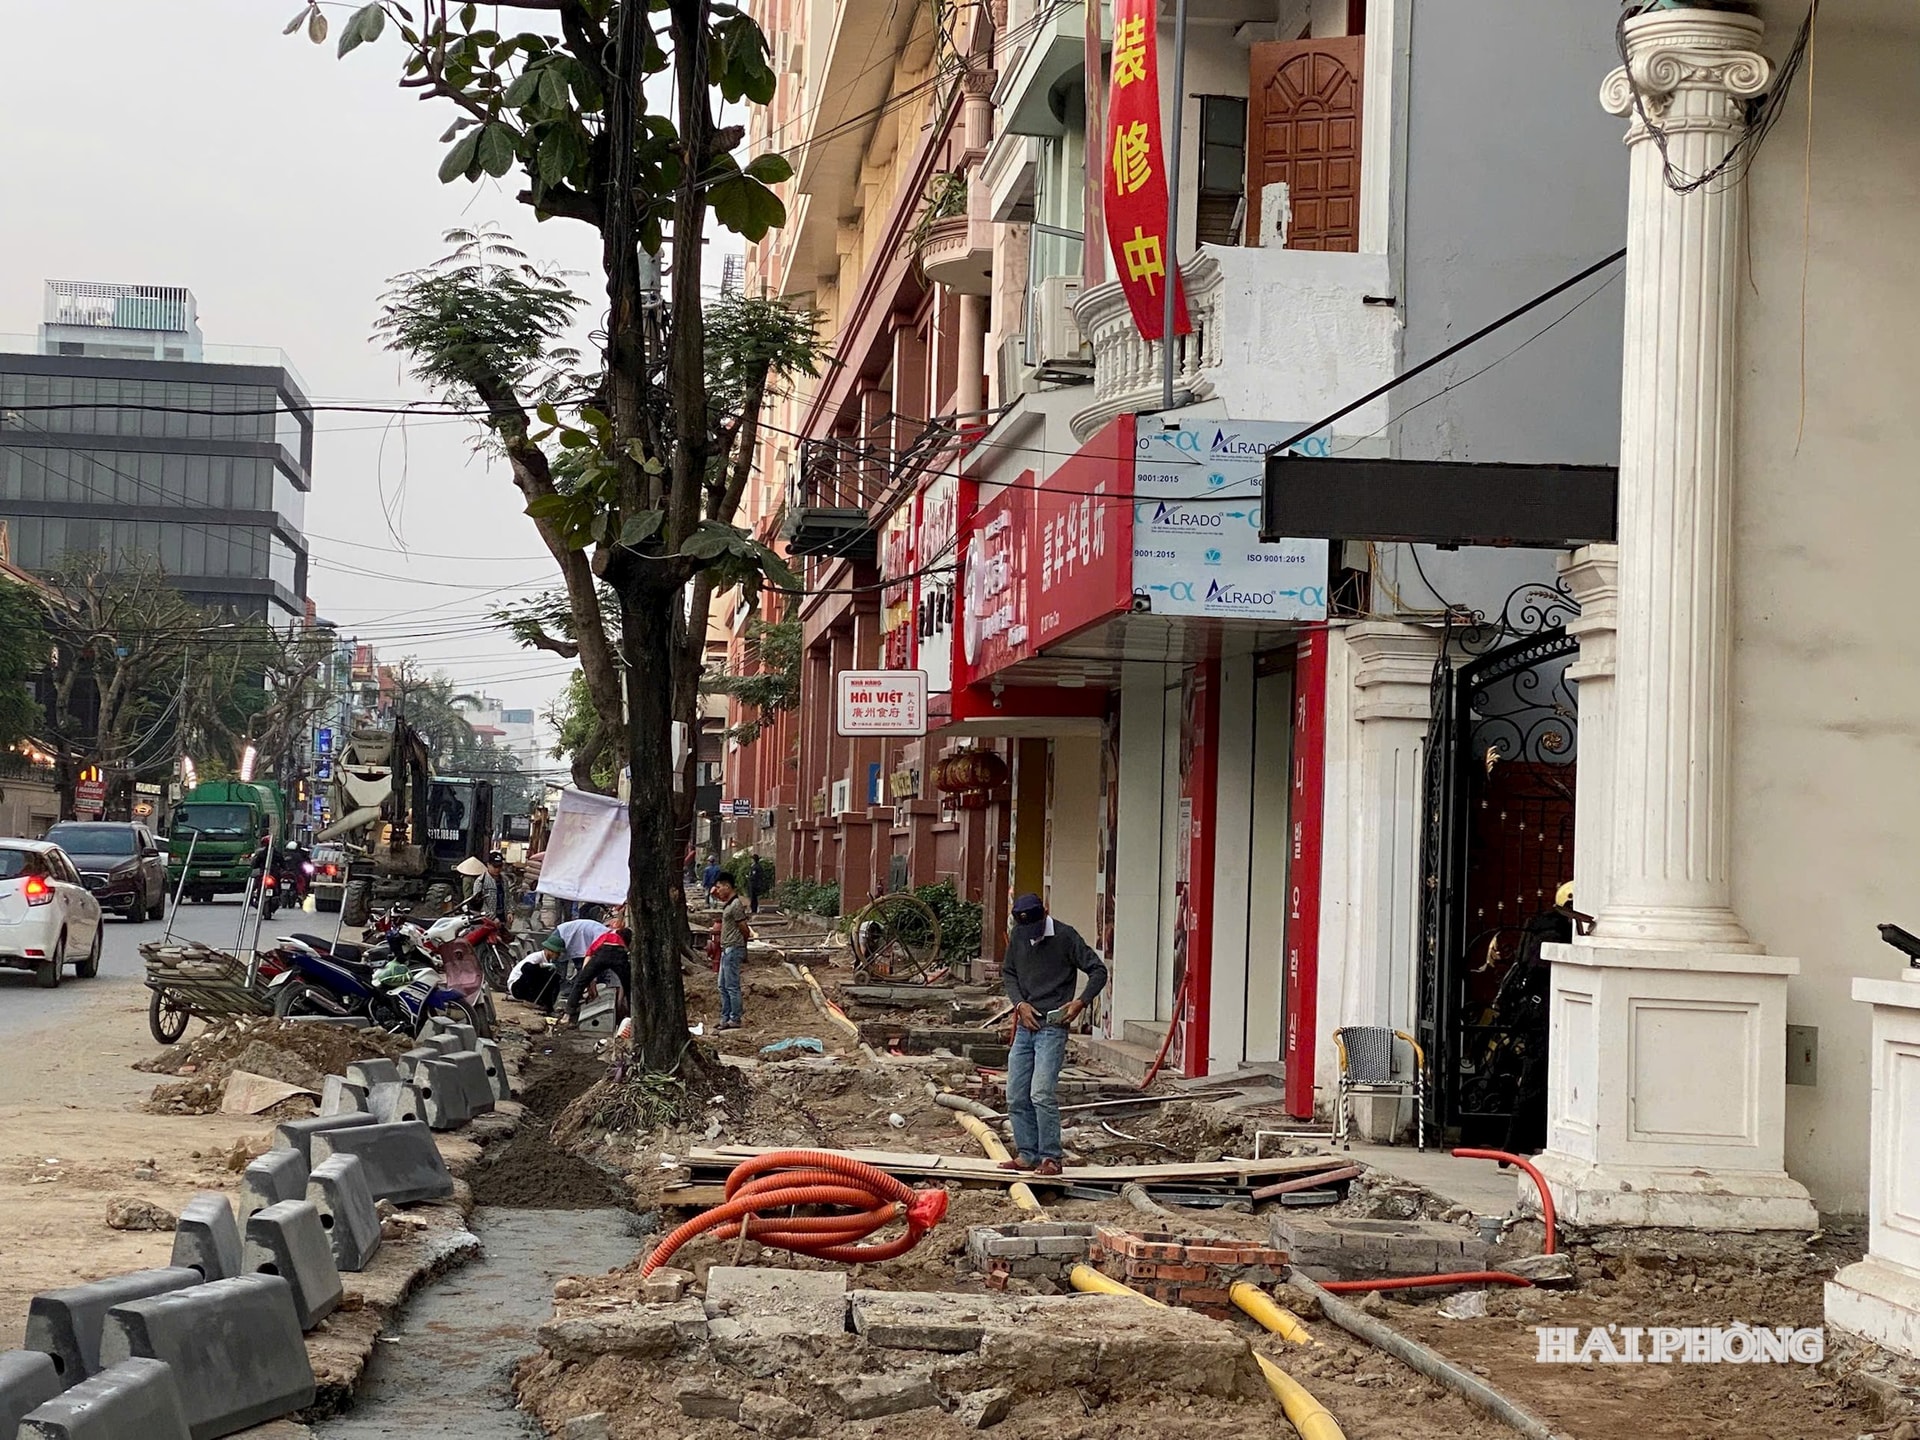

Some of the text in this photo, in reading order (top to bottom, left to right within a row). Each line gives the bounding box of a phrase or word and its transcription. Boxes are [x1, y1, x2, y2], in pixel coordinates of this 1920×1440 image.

[1113, 13, 1165, 297] 装修中
[1137, 474, 1179, 483] 9001:2015
[1152, 501, 1221, 527] ALRADO
[1247, 554, 1306, 563] ISO 9001:2015
[1205, 578, 1274, 605] ALRADO
[850, 689, 903, 706] HẢI VIỆT
